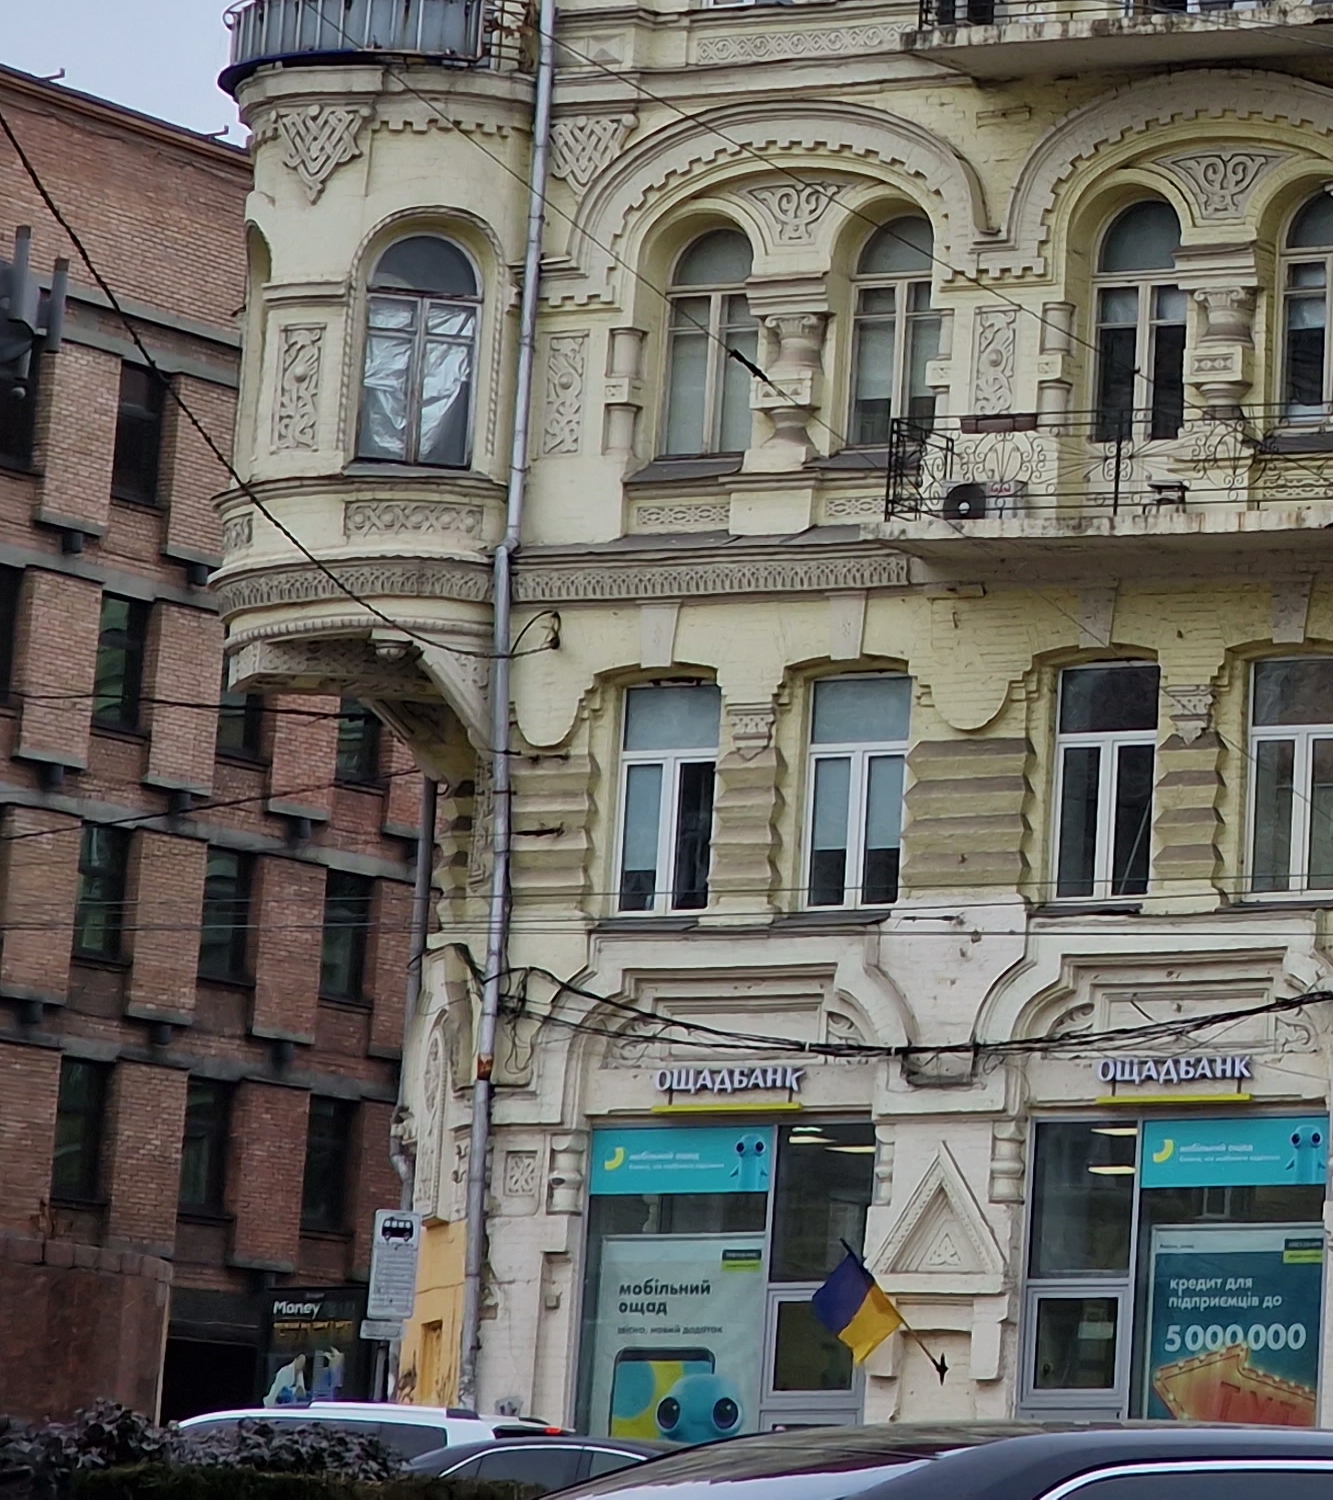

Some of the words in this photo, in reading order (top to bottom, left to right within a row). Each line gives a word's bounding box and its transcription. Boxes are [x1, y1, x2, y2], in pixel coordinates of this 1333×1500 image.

[1098, 1056, 1253, 1085] ОЩАДБАНК
[655, 1067, 805, 1095] ОЩАДБАНК
[618, 1278, 712, 1296] мобільний
[1169, 1278, 1223, 1296] кредит
[1225, 1277, 1253, 1291] для
[273, 1300, 322, 1320] Money
[618, 1301, 668, 1316] ощад
[1168, 1292, 1260, 1311] підприємців
[1262, 1295, 1283, 1309] до
